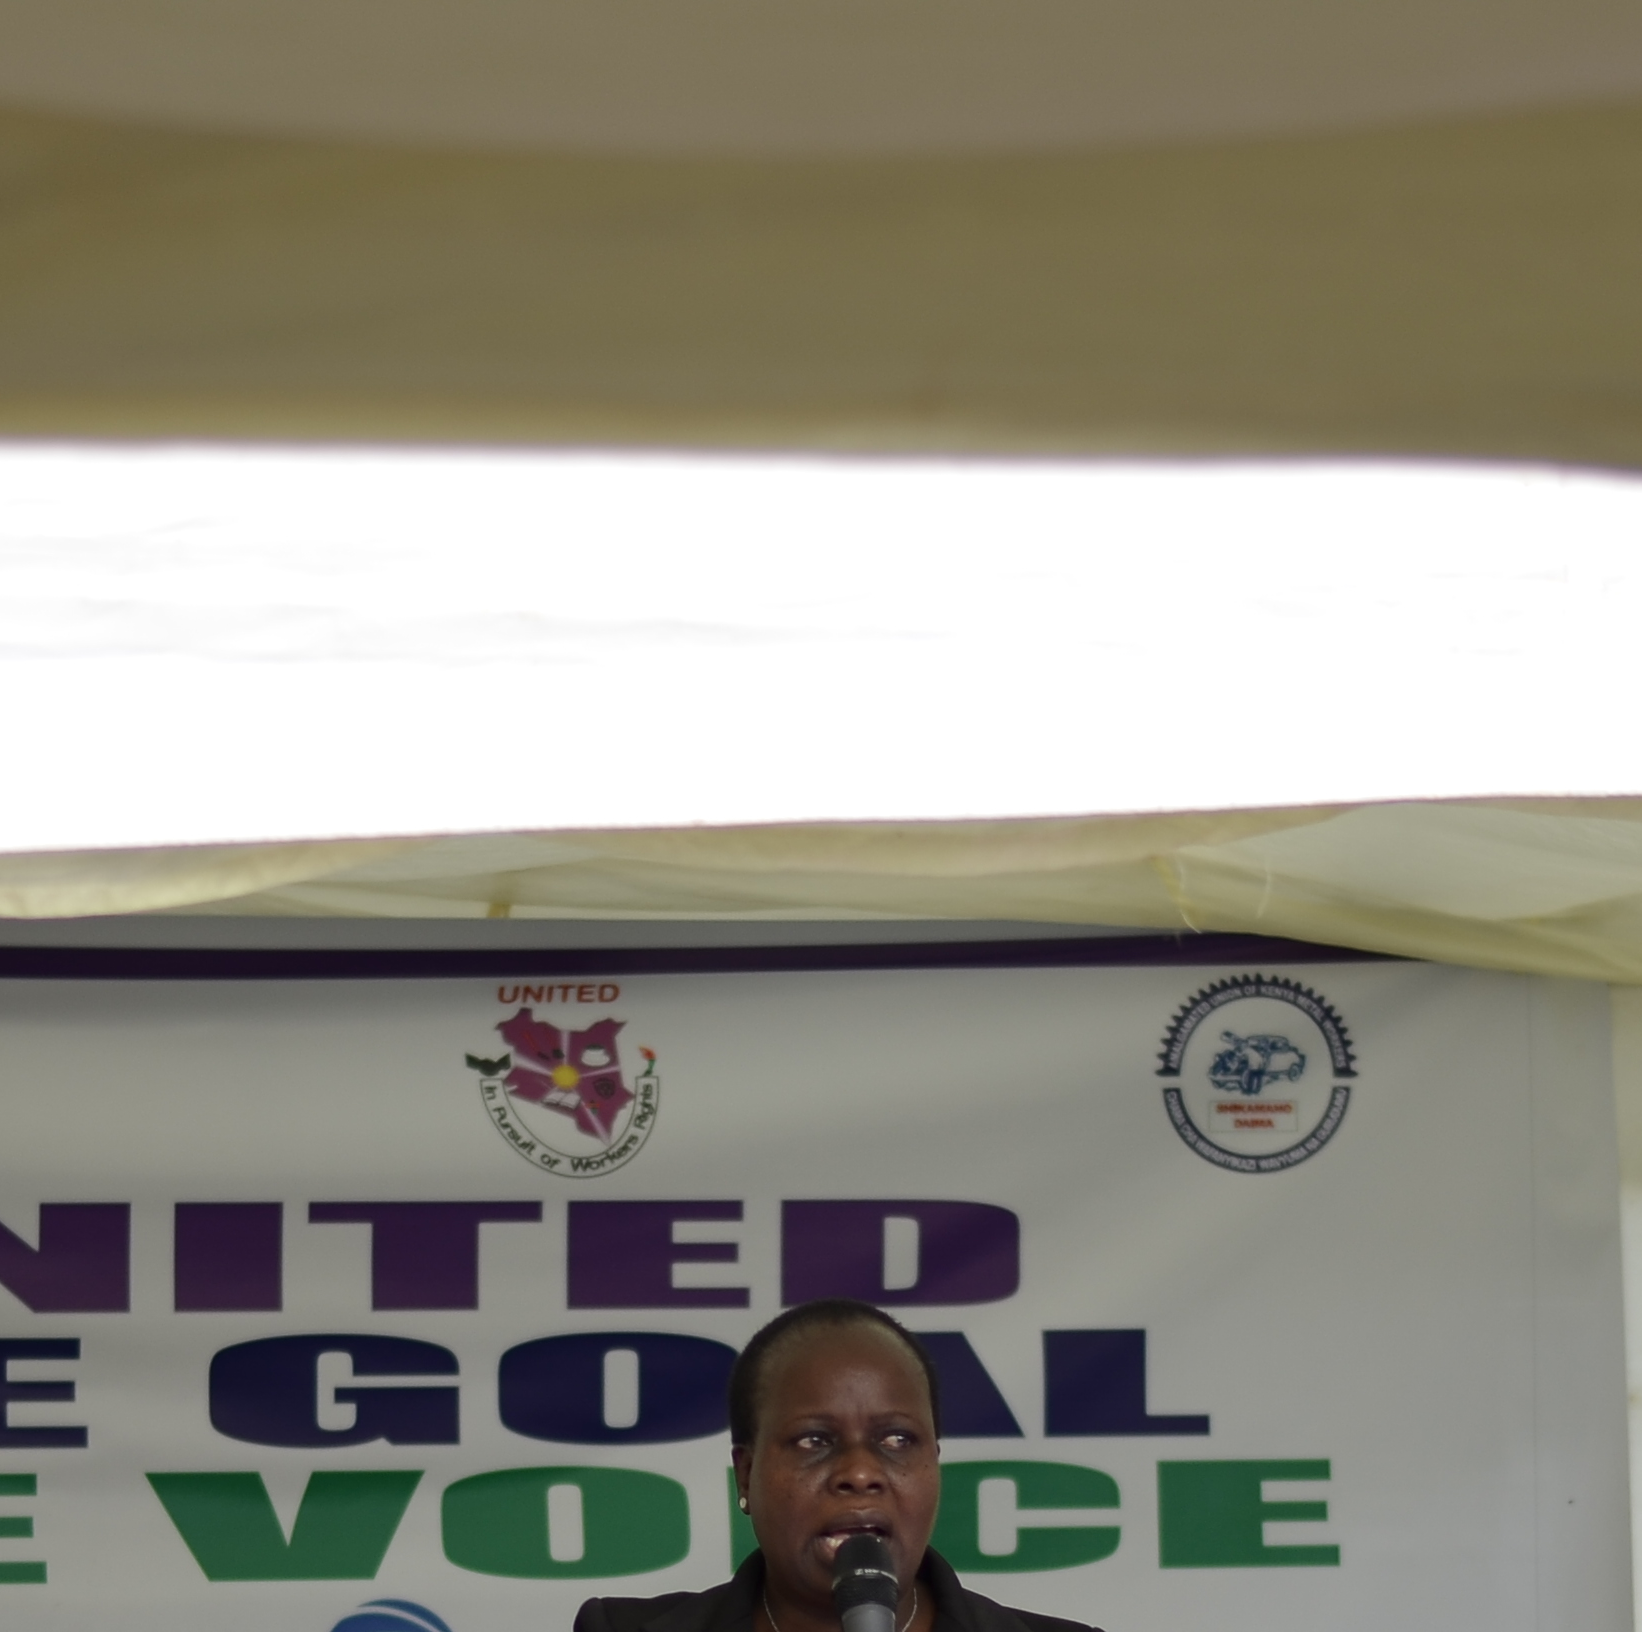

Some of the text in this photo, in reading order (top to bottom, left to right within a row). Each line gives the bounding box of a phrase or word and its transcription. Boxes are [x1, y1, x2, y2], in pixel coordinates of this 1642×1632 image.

[497, 983, 620, 1004] UNITED
[1260, 985, 1295, 1001] KENYA
[483, 1083, 653, 1172] In Pursuit of Workers Rights
[144, 1458, 1341, 1582] VOCE
